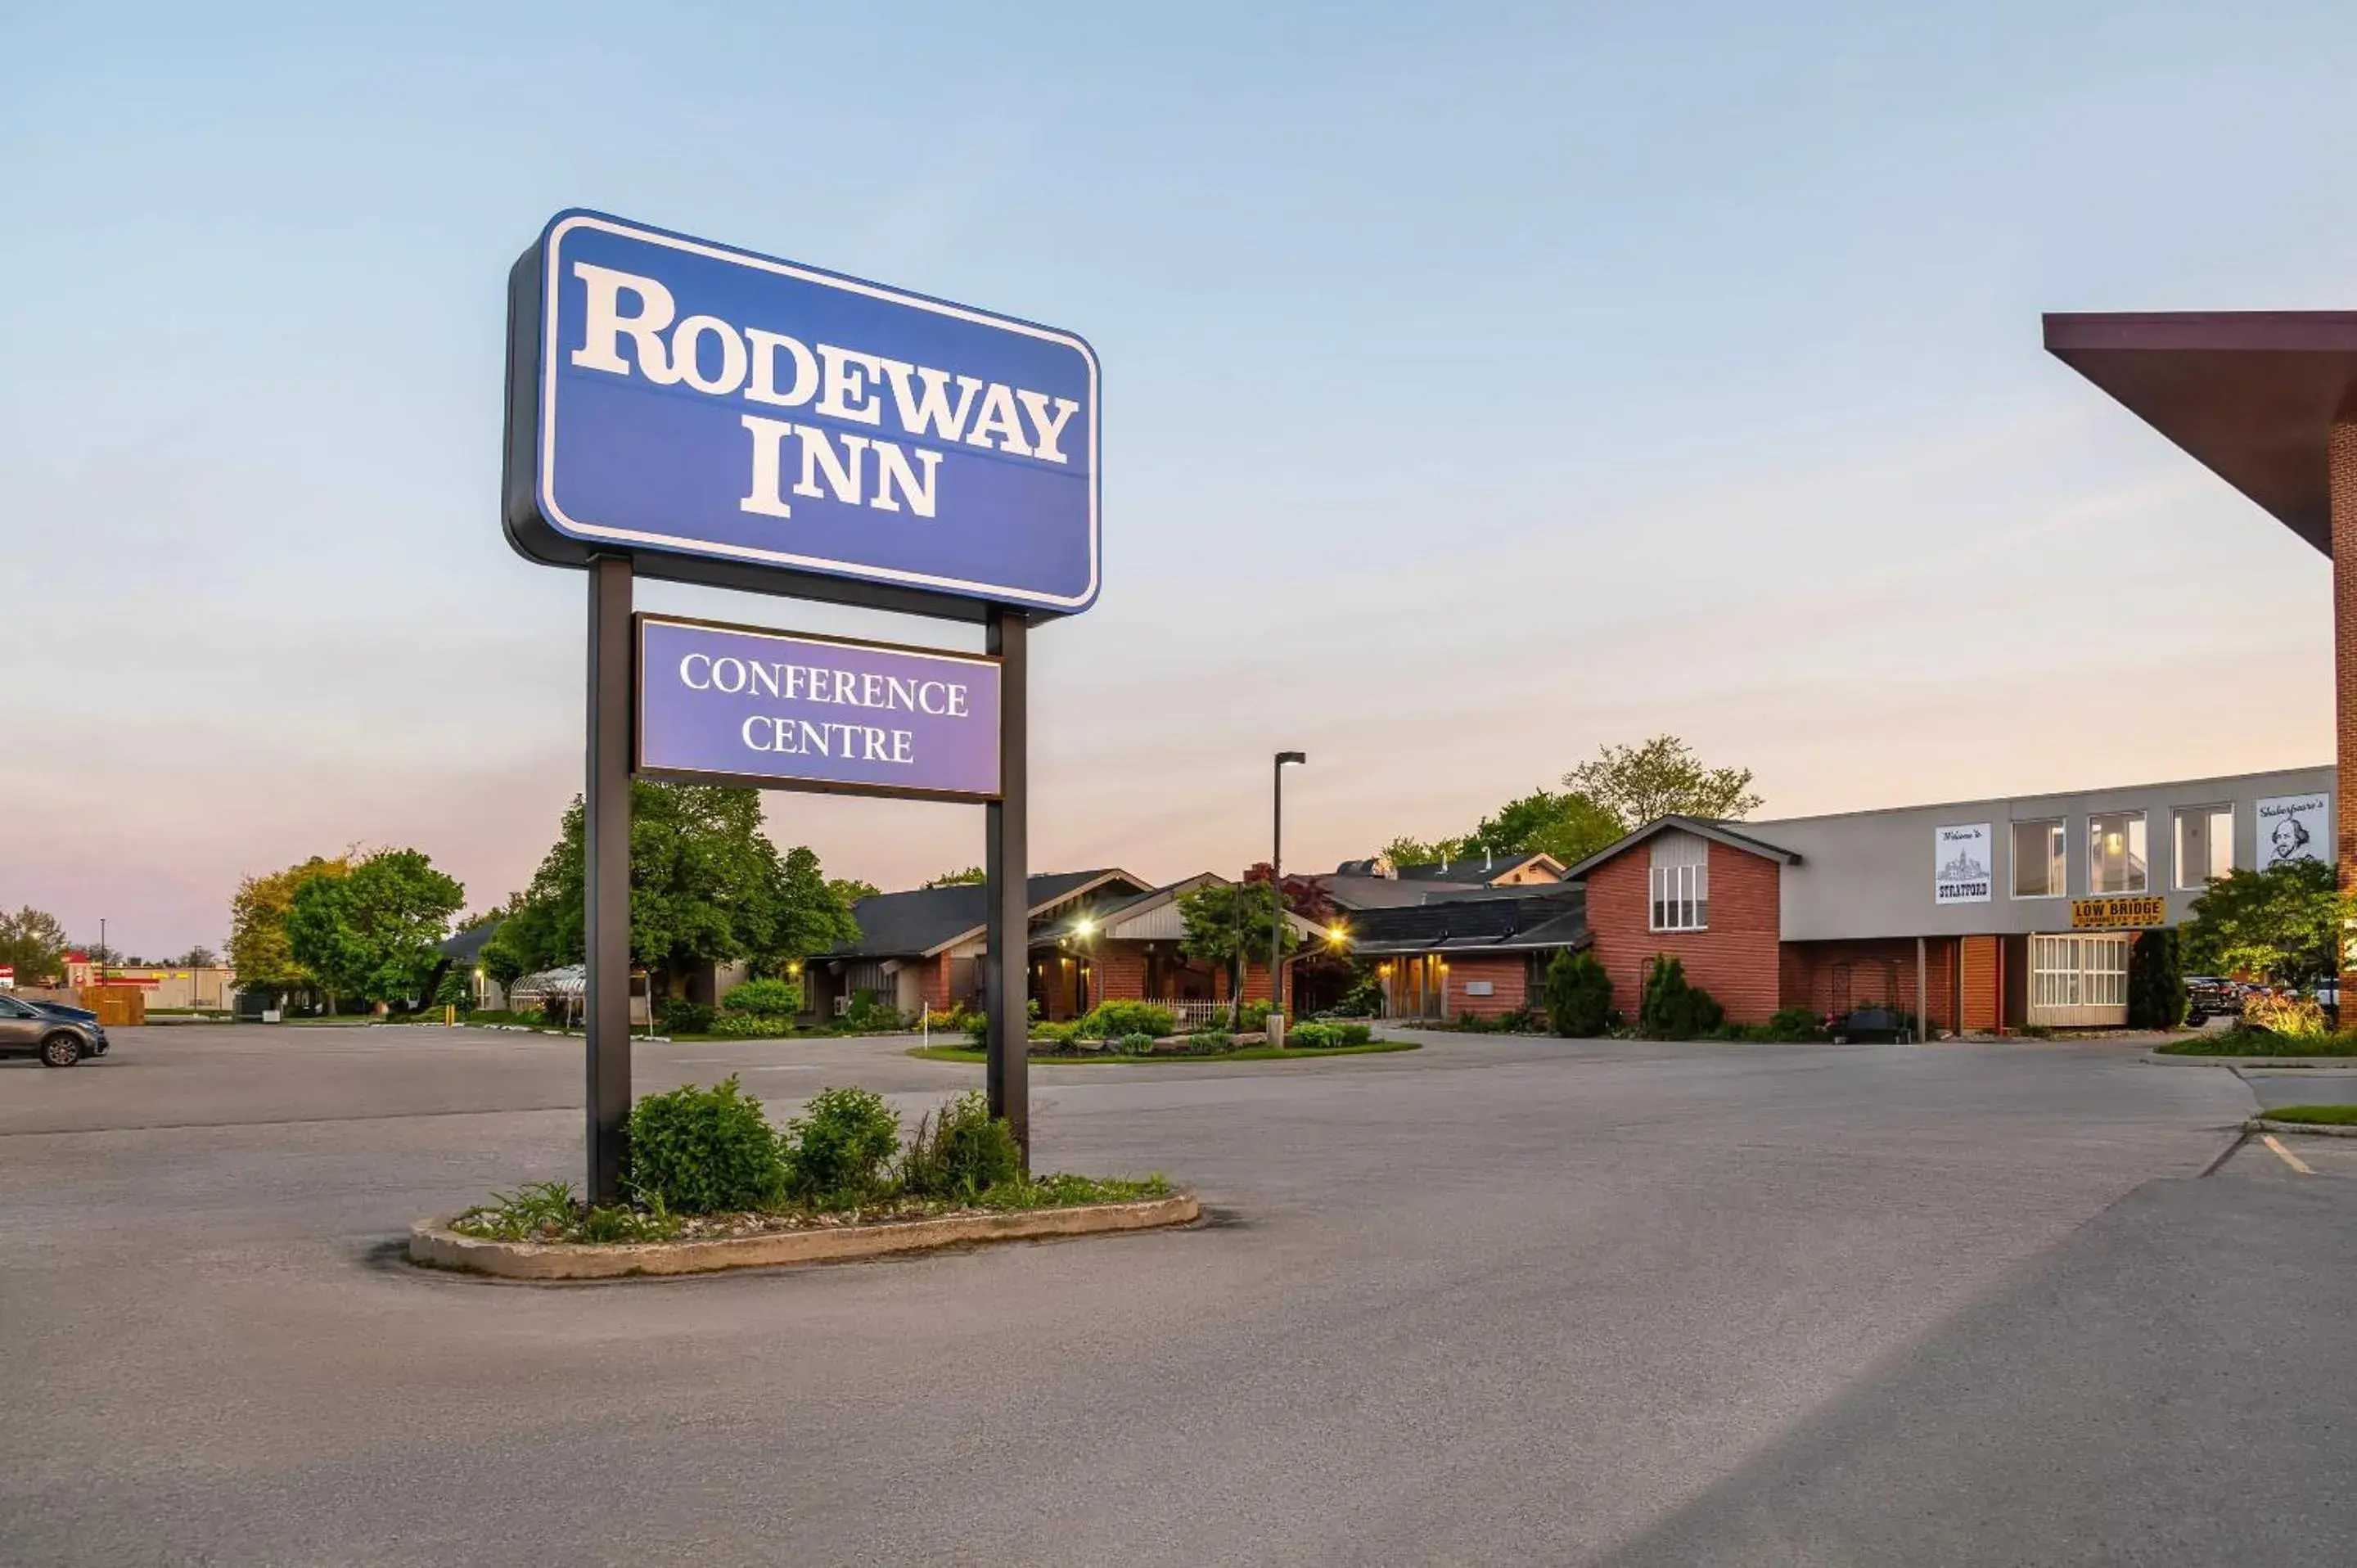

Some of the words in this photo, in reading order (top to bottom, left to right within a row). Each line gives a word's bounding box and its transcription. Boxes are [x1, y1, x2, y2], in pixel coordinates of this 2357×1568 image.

[571, 262, 1080, 465] RODEWAY
[740, 414, 944, 519] INN
[679, 653, 969, 717] CONFERENCE
[741, 715, 914, 764] CENTRE
[1939, 882, 1987, 898] STRATFORD
[2075, 904, 2104, 917] LOW
[2110, 901, 2161, 915] BRIDGE
